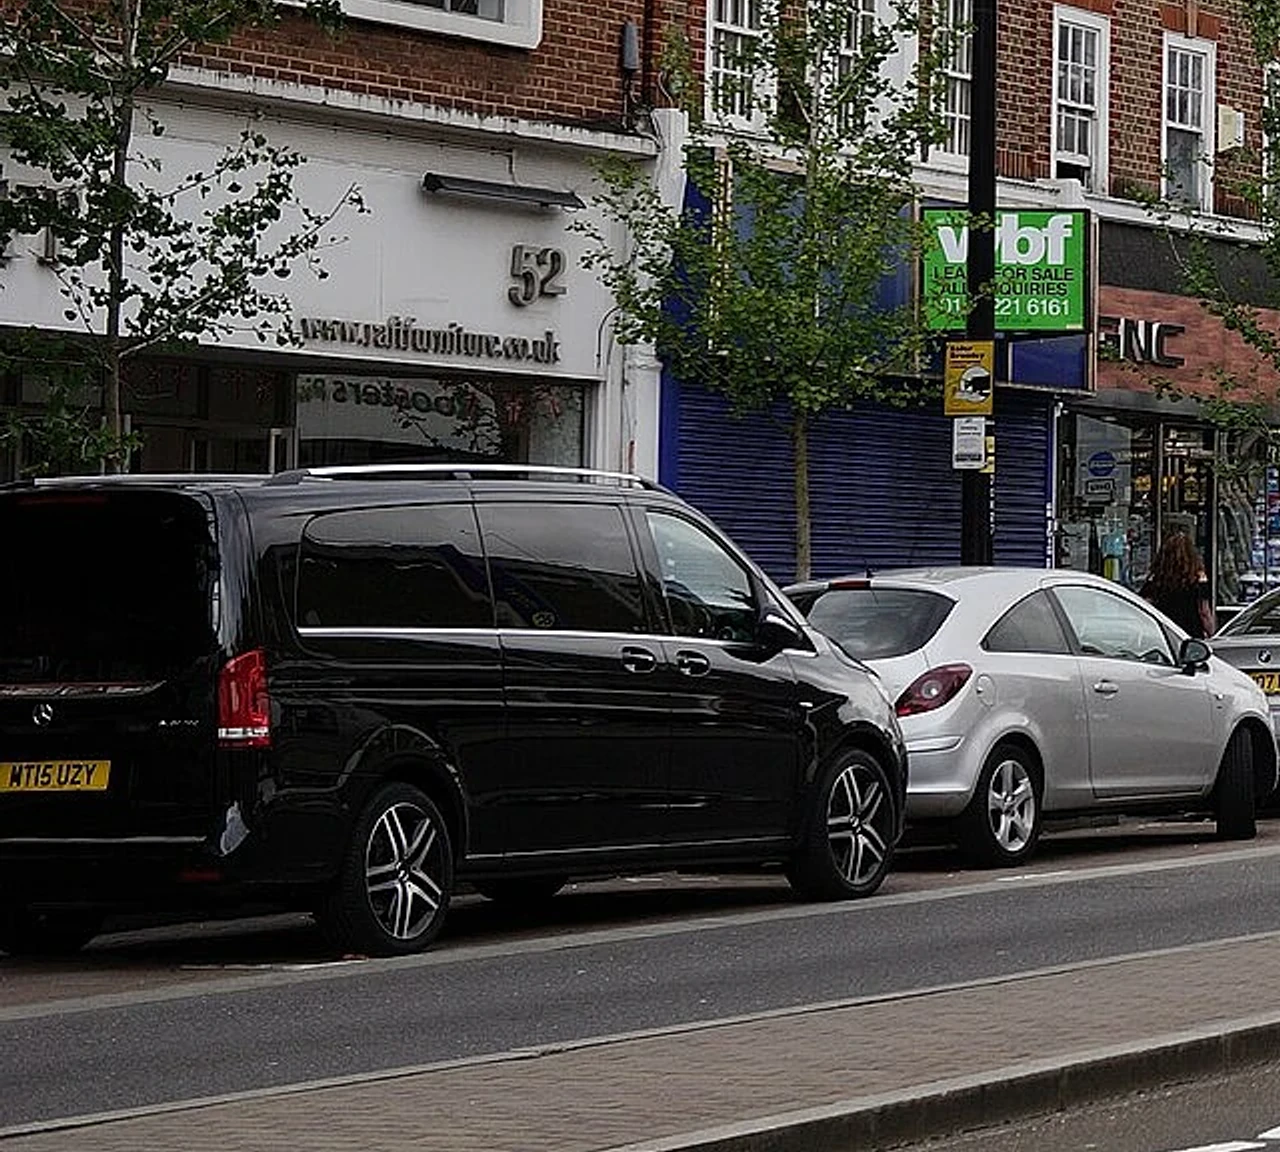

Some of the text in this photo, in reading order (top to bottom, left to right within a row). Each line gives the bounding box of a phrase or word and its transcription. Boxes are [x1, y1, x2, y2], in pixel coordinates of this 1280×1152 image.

[508, 244, 567, 308] 52
[1031, 267, 1075, 281] SALE
[1027, 298, 1070, 316] 6161
[56, 763, 97, 786] UZY
